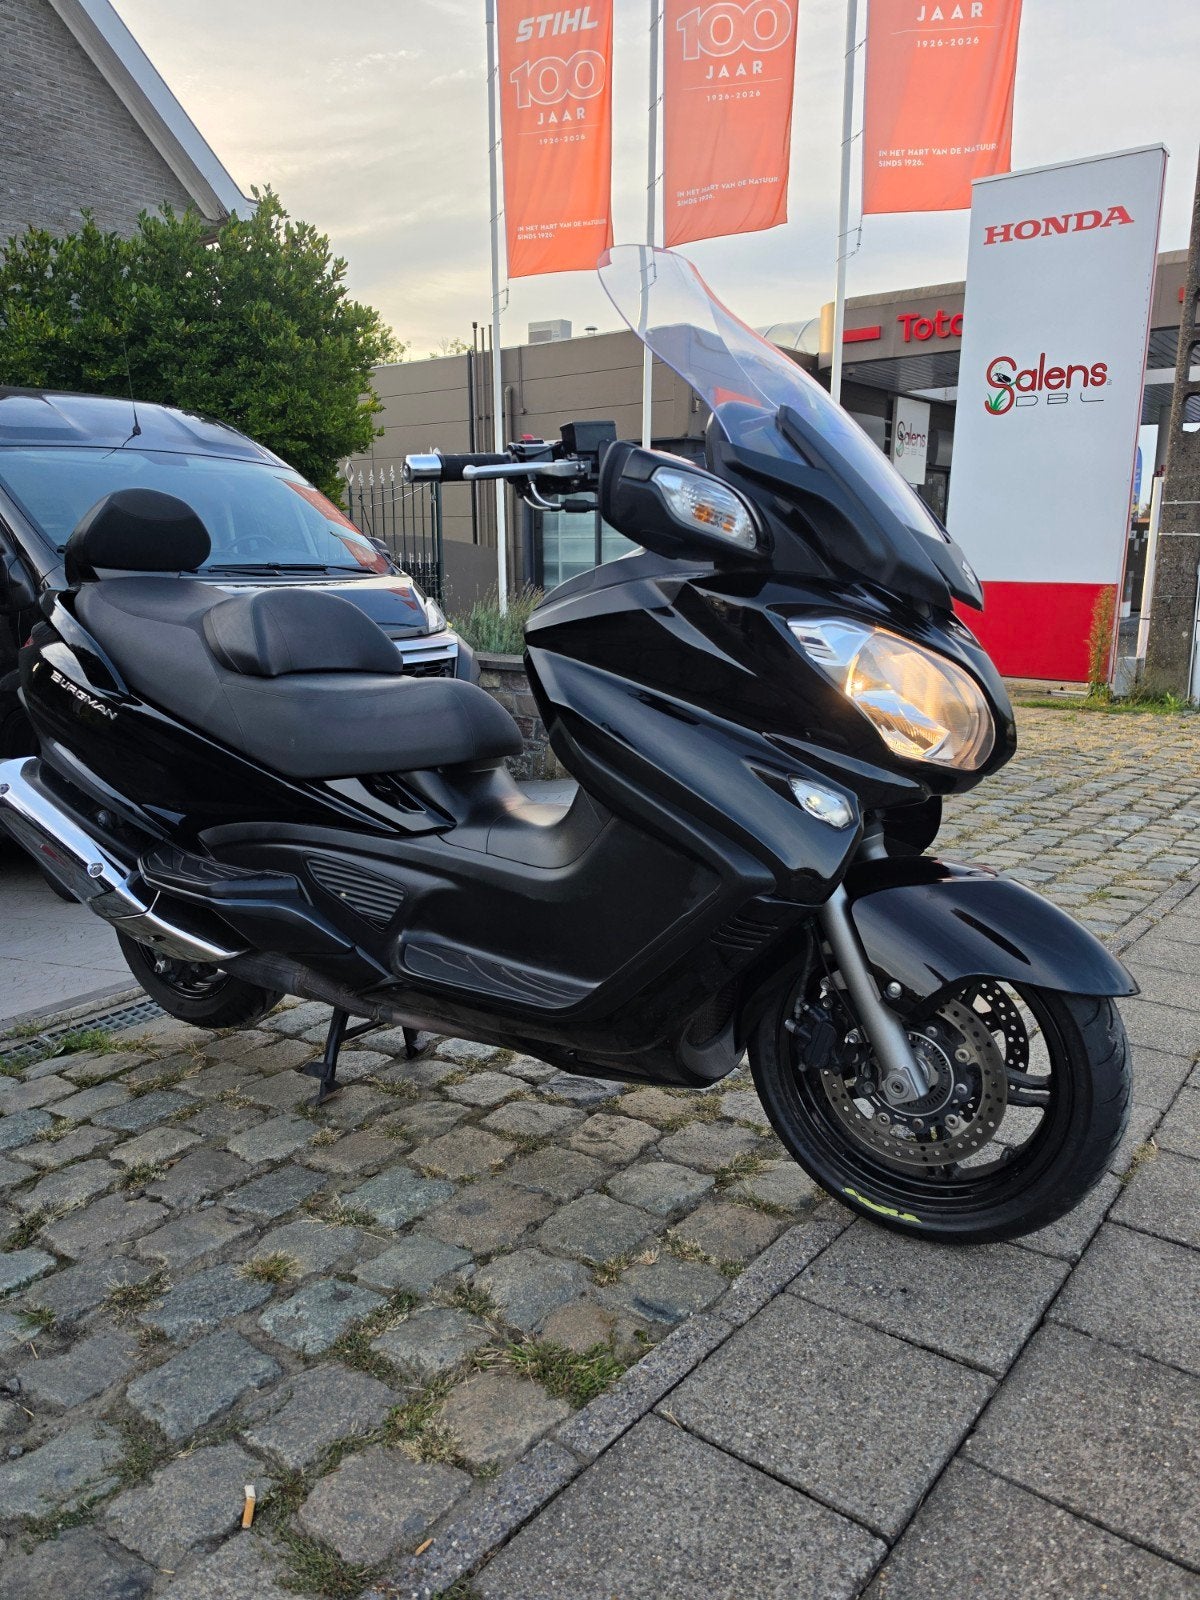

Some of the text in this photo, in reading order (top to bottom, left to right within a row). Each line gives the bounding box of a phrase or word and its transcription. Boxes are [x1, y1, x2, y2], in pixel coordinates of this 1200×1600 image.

[916, 2, 984, 22] JAAR
[515, 6, 599, 43] STIHL
[676, 0, 793, 61] 100
[916, 36, 980, 48] 1926-2026
[509, 49, 606, 109] 100
[705, 60, 764, 80] JAAR
[706, 89, 762, 102] 1926-2026
[537, 107, 586, 126] JAAR
[538, 134, 586, 146] 1926-2026
[878, 149, 887, 157] IN
[889, 149, 905, 157] HET
[907, 148, 929, 156] HART
[931, 147, 948, 155] VAN
[878, 160, 902, 168] SINDS
[686, 188, 700, 196] HET
[737, 179, 746, 187] DE
[540, 222, 558, 230] HART
[983, 205, 1135, 245] HONDA
[984, 352, 1107, 415] Salens
[1015, 392, 1104, 408] DBL
[896, 421, 926, 457] Salens
[50, 669, 118, 720] BURGMAN
